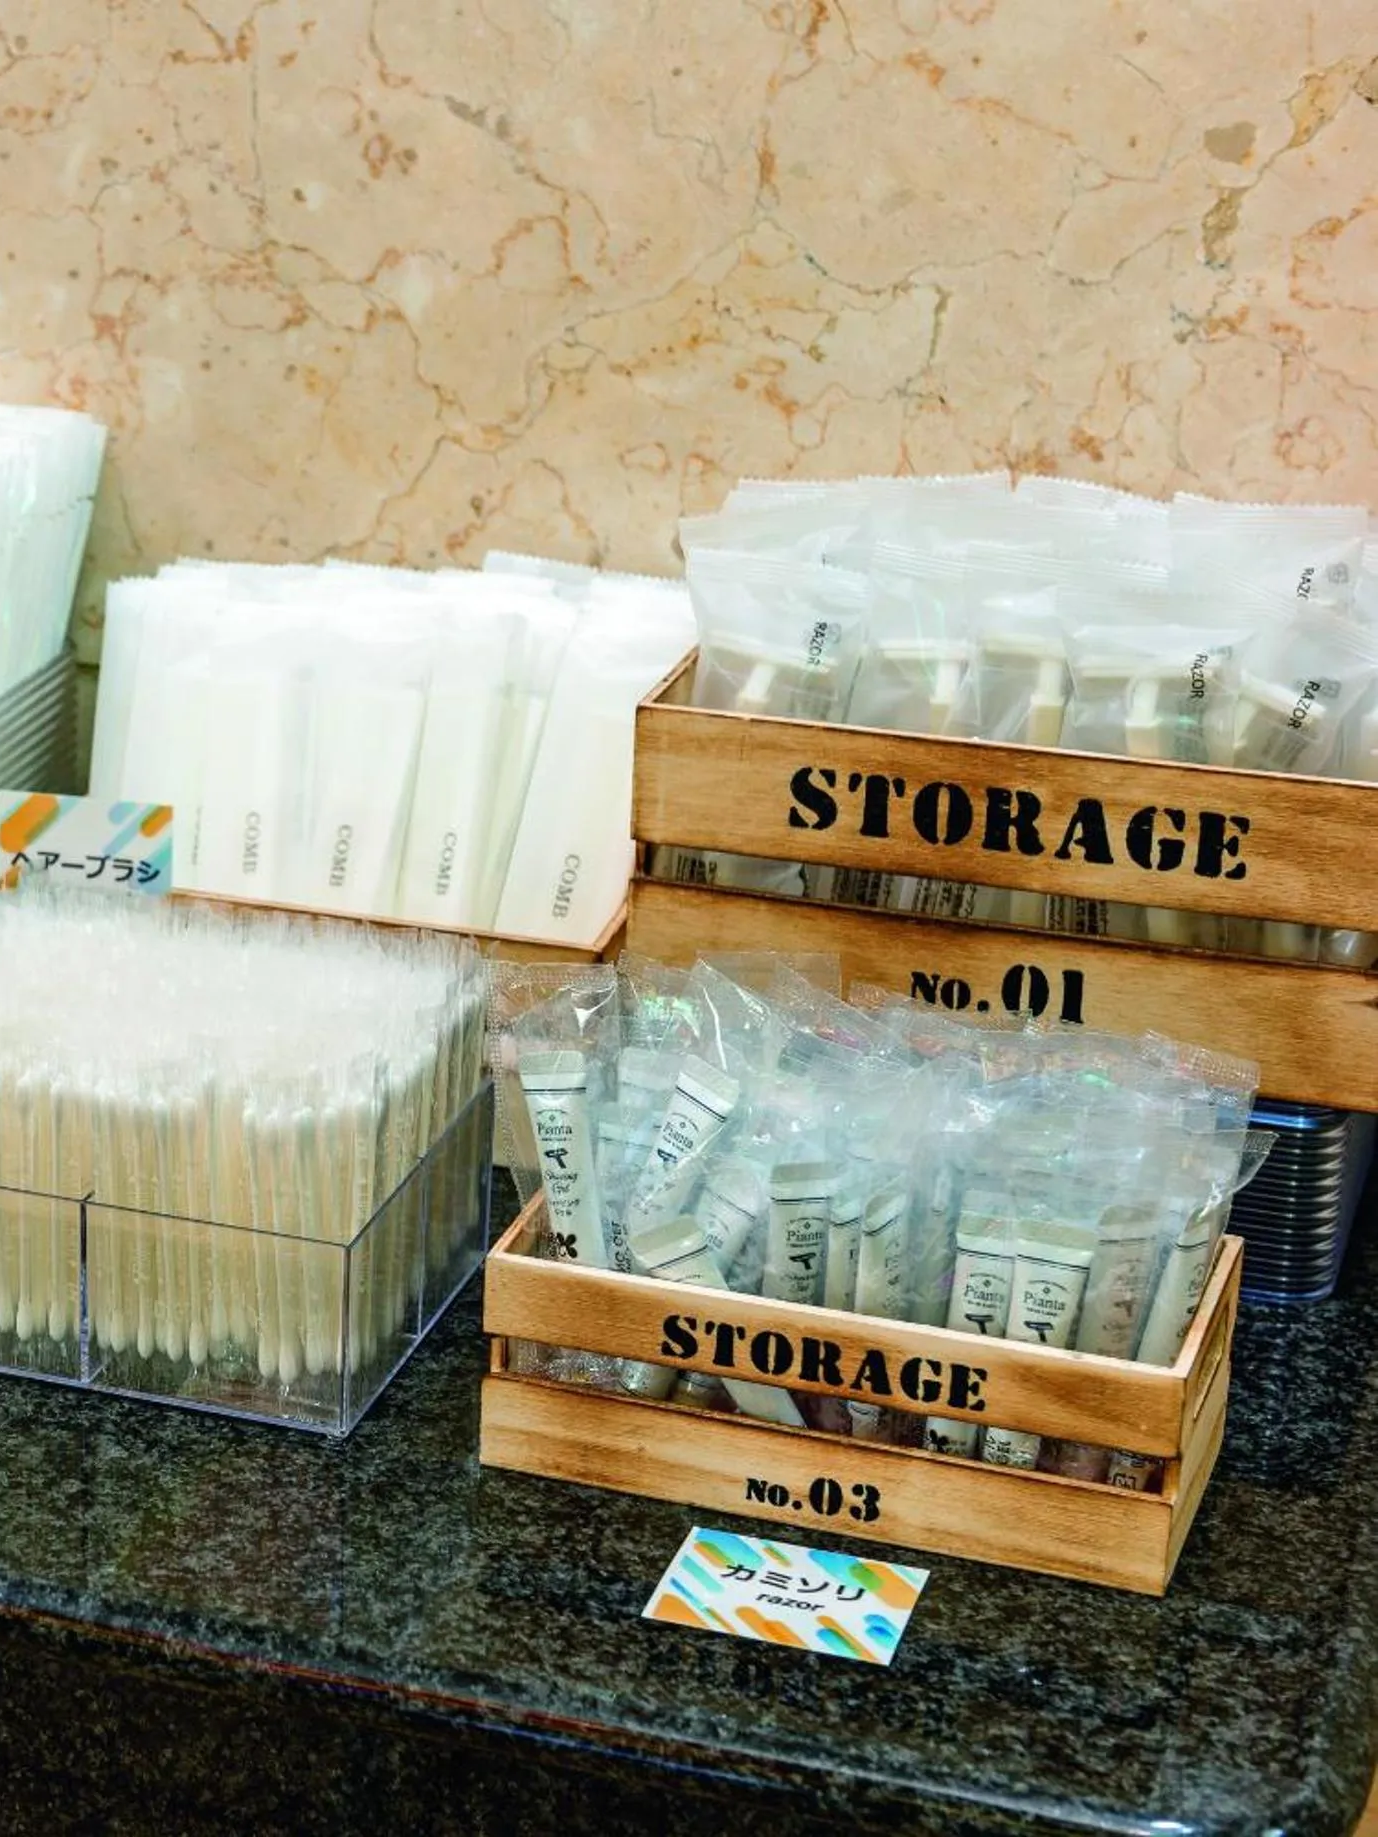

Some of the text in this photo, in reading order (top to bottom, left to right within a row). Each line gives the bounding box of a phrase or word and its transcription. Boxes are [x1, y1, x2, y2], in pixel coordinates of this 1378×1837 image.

[807, 621, 828, 667] RAZOR
[1189, 653, 1209, 700] RAZOR
[1287, 680, 1321, 730] RAZOR
[242, 810, 262, 875] COMB
[787, 766, 1251, 881] STORAGE
[328, 823, 353, 889] COMB
[435, 830, 458, 897] COMB
[550, 852, 582, 920] COMB
[911, 964, 1085, 1024] No.01
[660, 1314, 989, 1413] STORAGE
[744, 1477, 882, 1523] No.03
[719, 1563, 867, 1602] カミソリ
[755, 1592, 826, 1613] razor
